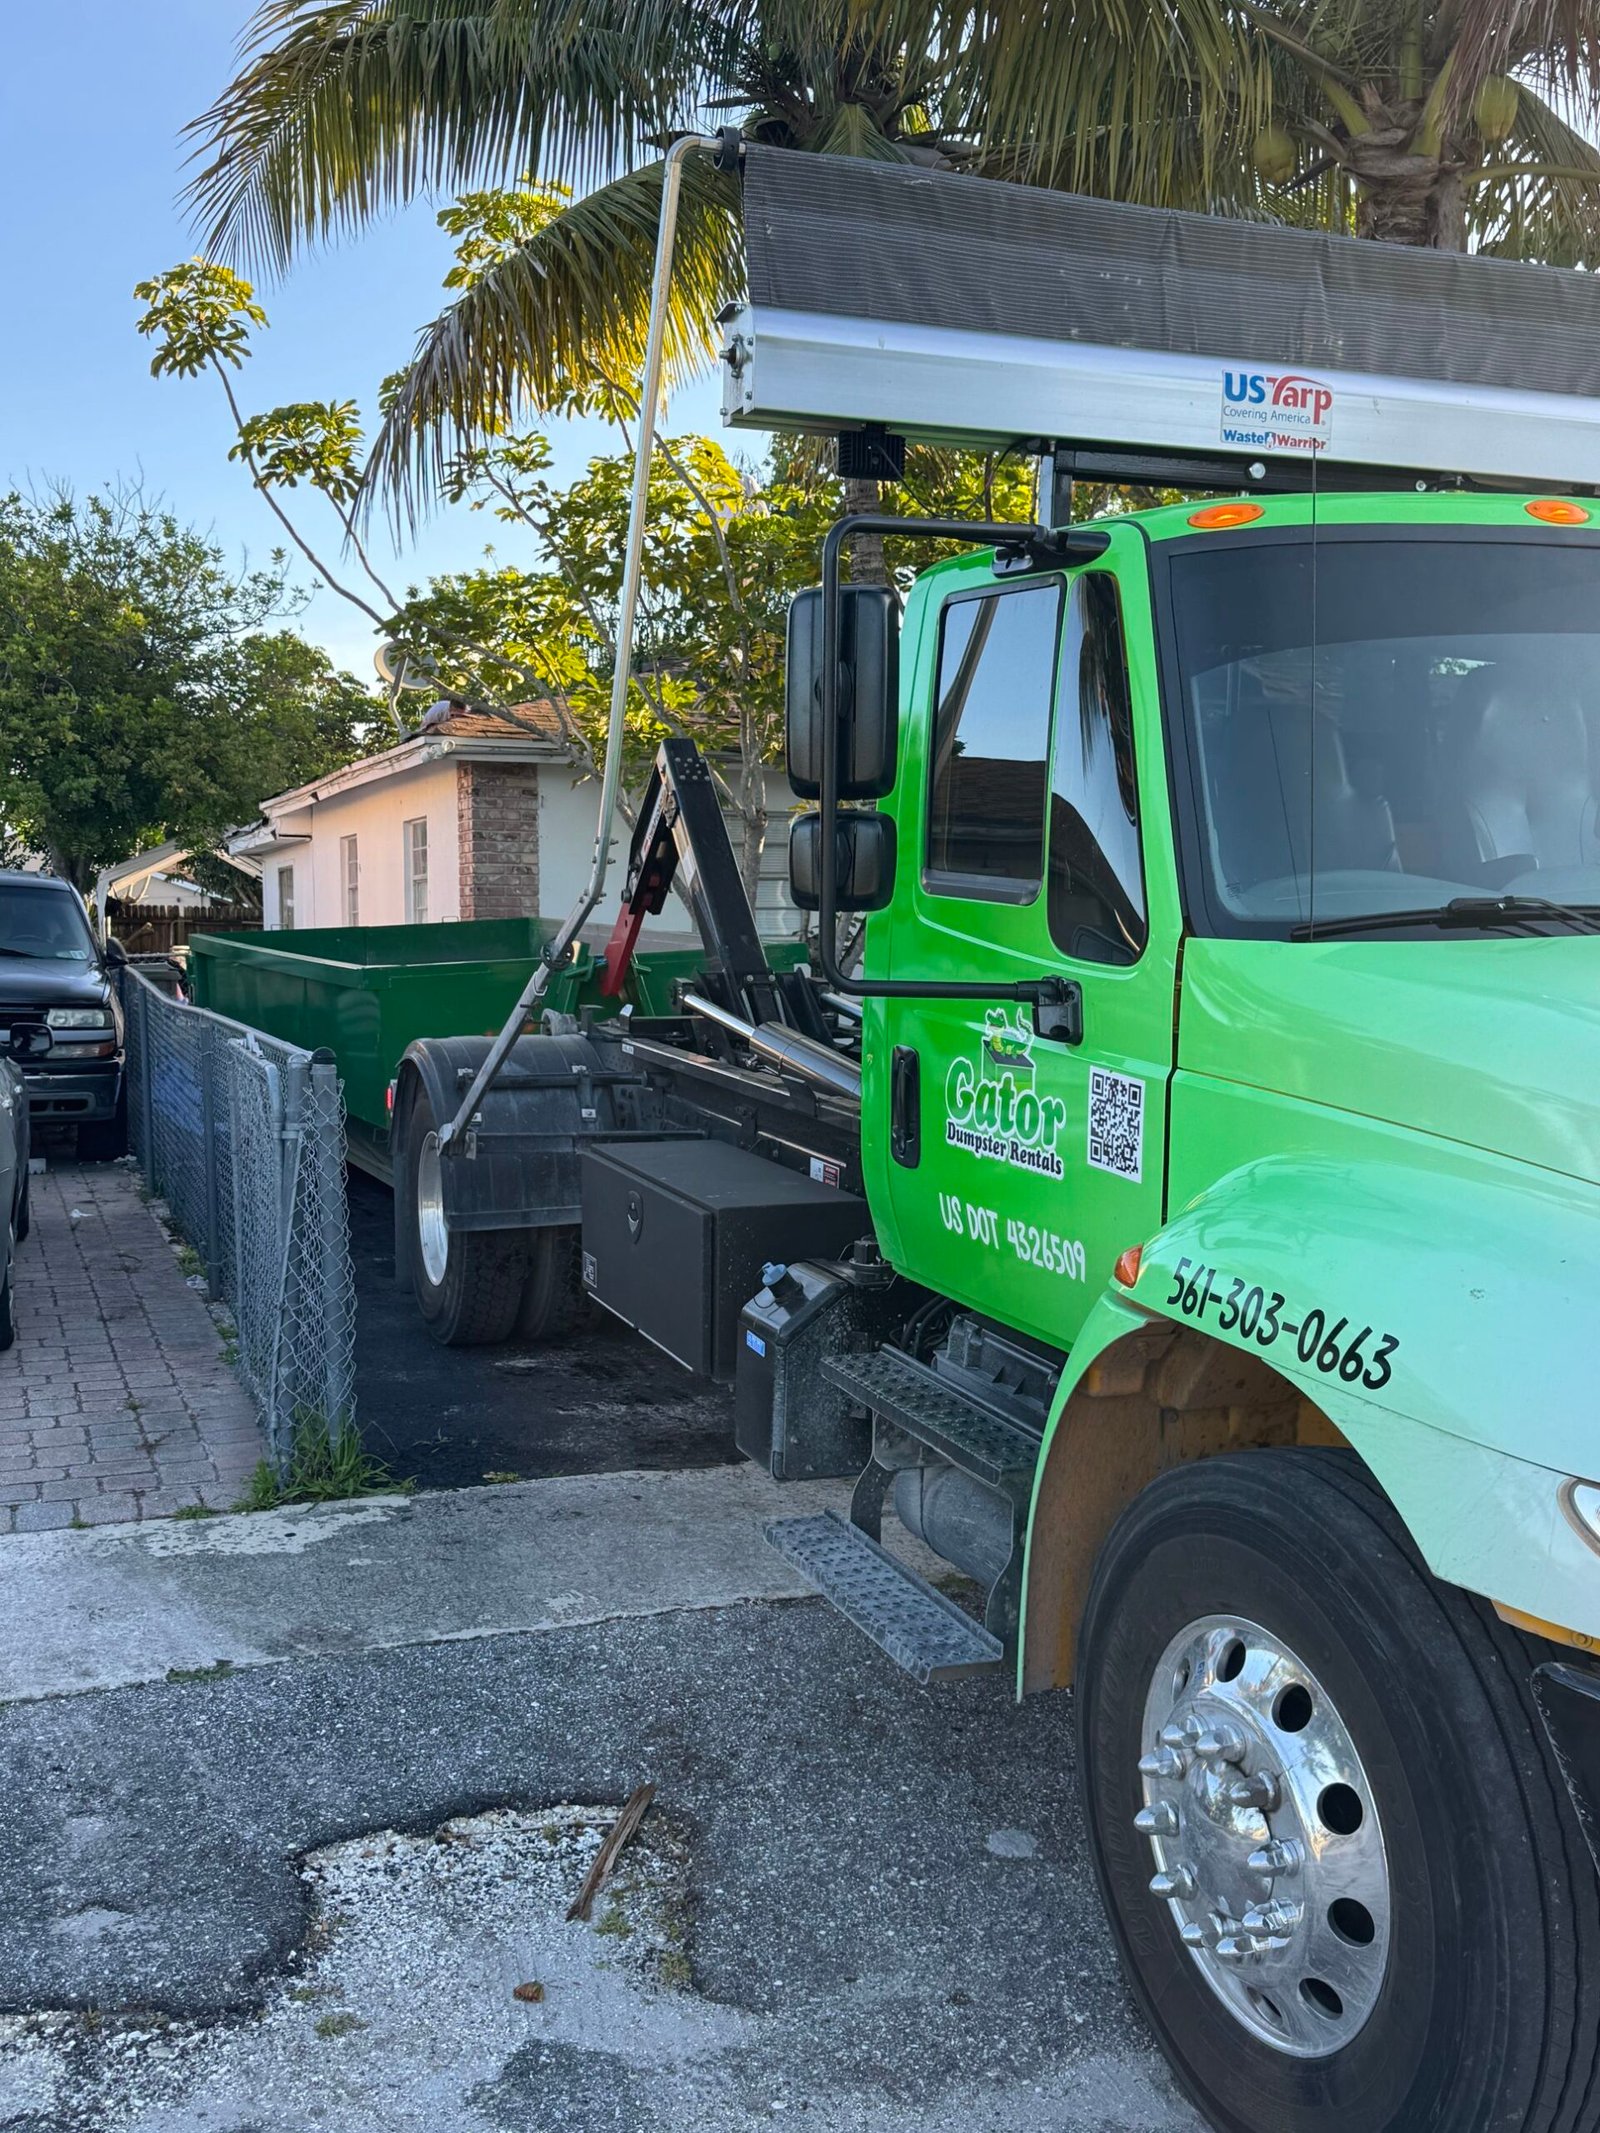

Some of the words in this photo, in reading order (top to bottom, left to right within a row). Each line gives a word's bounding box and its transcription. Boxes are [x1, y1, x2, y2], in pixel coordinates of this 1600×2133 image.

[1223, 405, 1267, 422] Covering
[1270, 410, 1311, 424] America
[1223, 429, 1263, 444] Waste
[1275, 434, 1326, 449] Warrior
[946, 1057, 1066, 1149] Gator
[947, 1120, 1007, 1157] Dumpster
[1009, 1141, 1062, 1175] Rentals
[939, 1192, 963, 1235] US
[966, 1203, 999, 1250] DOT
[1007, 1218, 1085, 1284] 4326509
[1166, 1257, 1400, 1390] 561-303-0663
